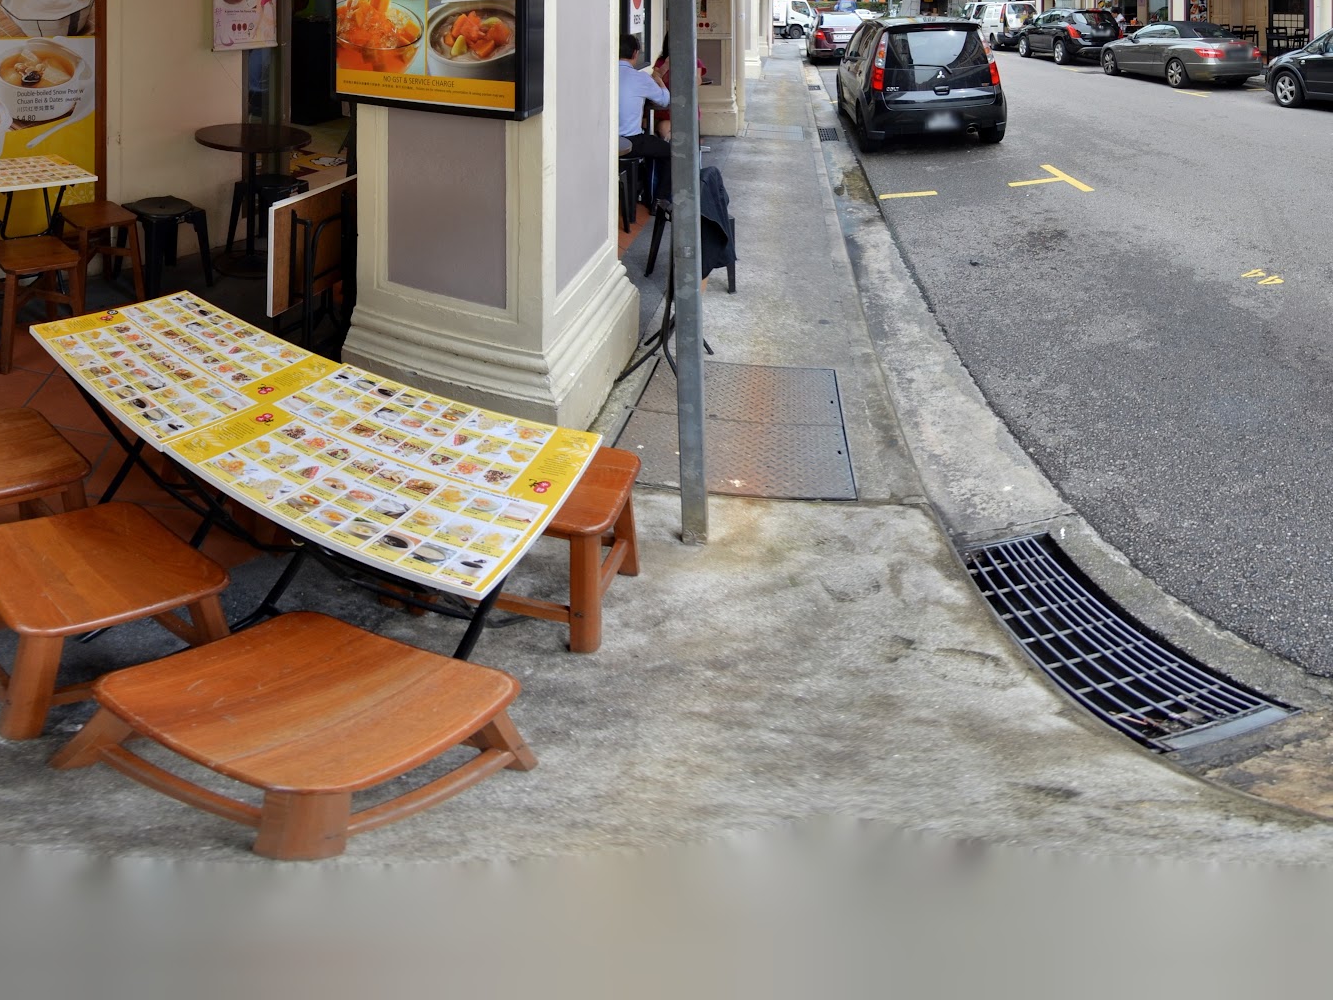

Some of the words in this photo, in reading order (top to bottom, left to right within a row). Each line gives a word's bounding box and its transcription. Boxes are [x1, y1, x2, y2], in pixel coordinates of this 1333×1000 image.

[392, 76, 403, 84] GST
[409, 77, 431, 86] SERVICE
[432, 79, 455, 88] CHARGE
[17, 89, 52, 97] Double-boiled
